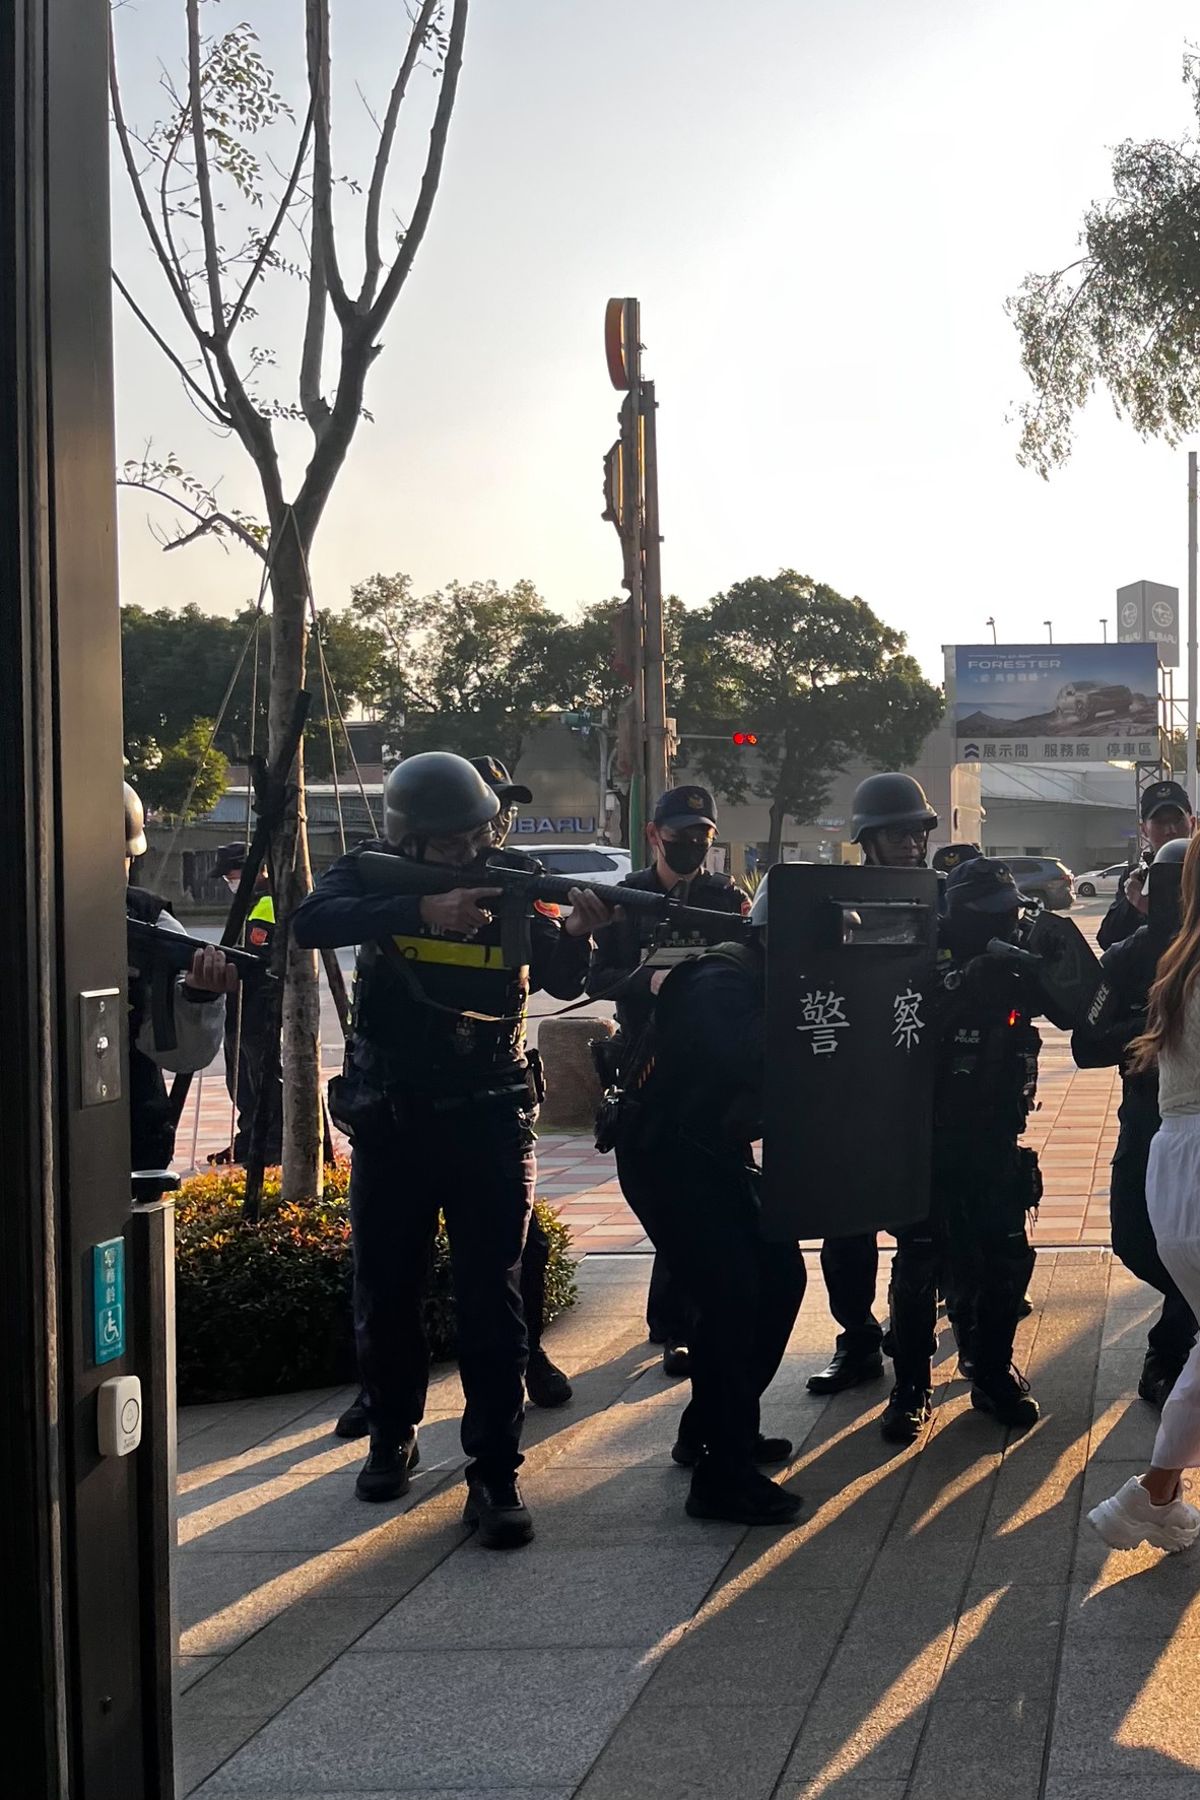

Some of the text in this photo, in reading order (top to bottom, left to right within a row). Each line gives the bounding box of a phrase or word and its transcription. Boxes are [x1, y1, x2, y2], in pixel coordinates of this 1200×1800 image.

[968, 660, 1062, 669] FORESTER
[983, 742, 1152, 757] 展示間 服務廠 停車區
[511, 817, 594, 832] BARU
[1088, 983, 1110, 1025] POLICE
[954, 1035, 981, 1044] POLICE
